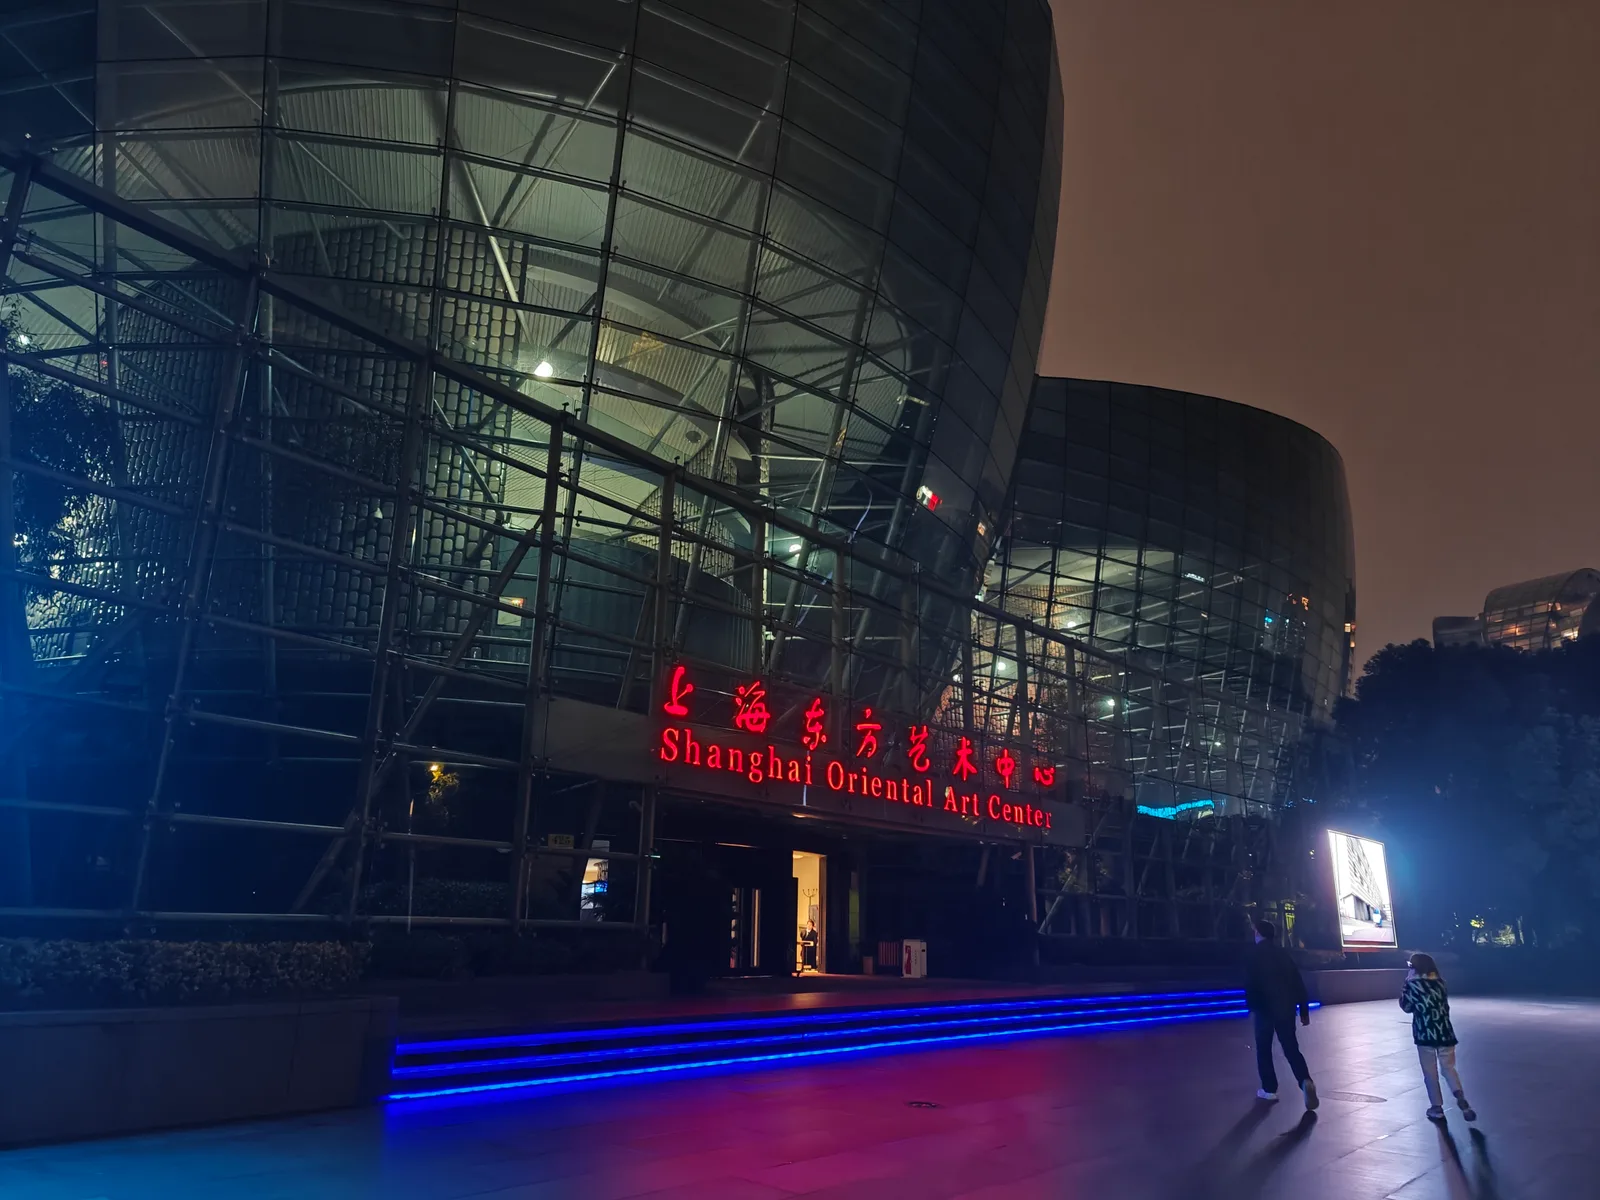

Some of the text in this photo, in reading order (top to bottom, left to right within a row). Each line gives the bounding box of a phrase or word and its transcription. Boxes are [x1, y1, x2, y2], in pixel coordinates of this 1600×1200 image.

[659, 725, 1052, 829] Shanghai Oriental Art Center
[662, 665, 1056, 789] 上海东方艺术中心
